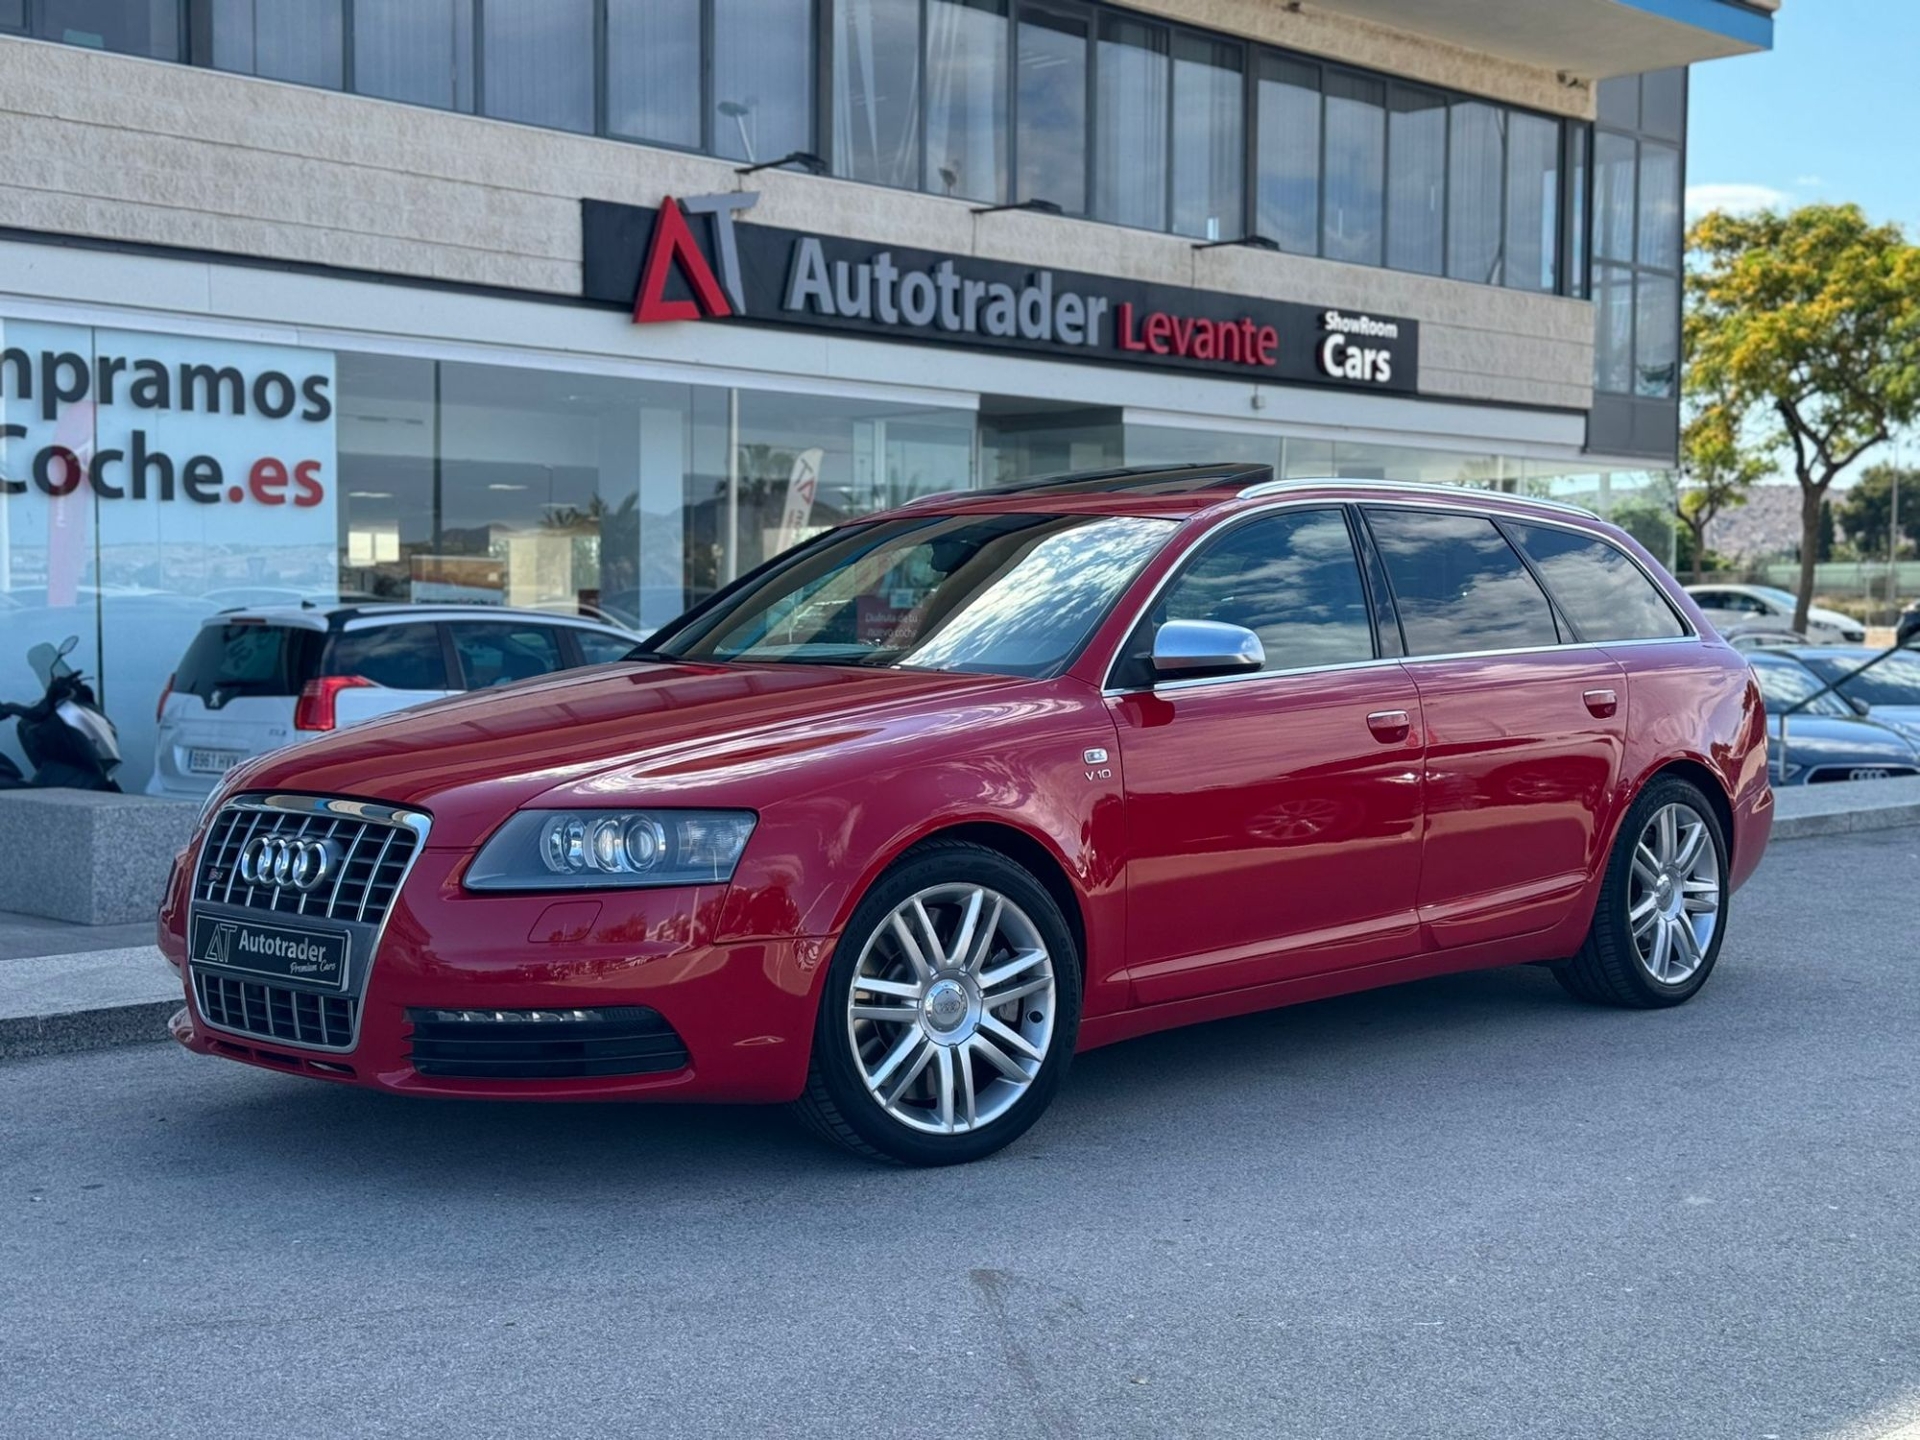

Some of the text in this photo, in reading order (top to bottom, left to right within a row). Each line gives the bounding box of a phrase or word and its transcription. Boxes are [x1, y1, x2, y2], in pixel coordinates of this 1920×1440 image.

[783, 237, 1279, 366] Autotrader Levante
[1322, 310, 1398, 339] ShowRoom
[1321, 333, 1392, 382] Cars
[238, 929, 326, 963] Autotrader
[319, 958, 337, 973] Cars
